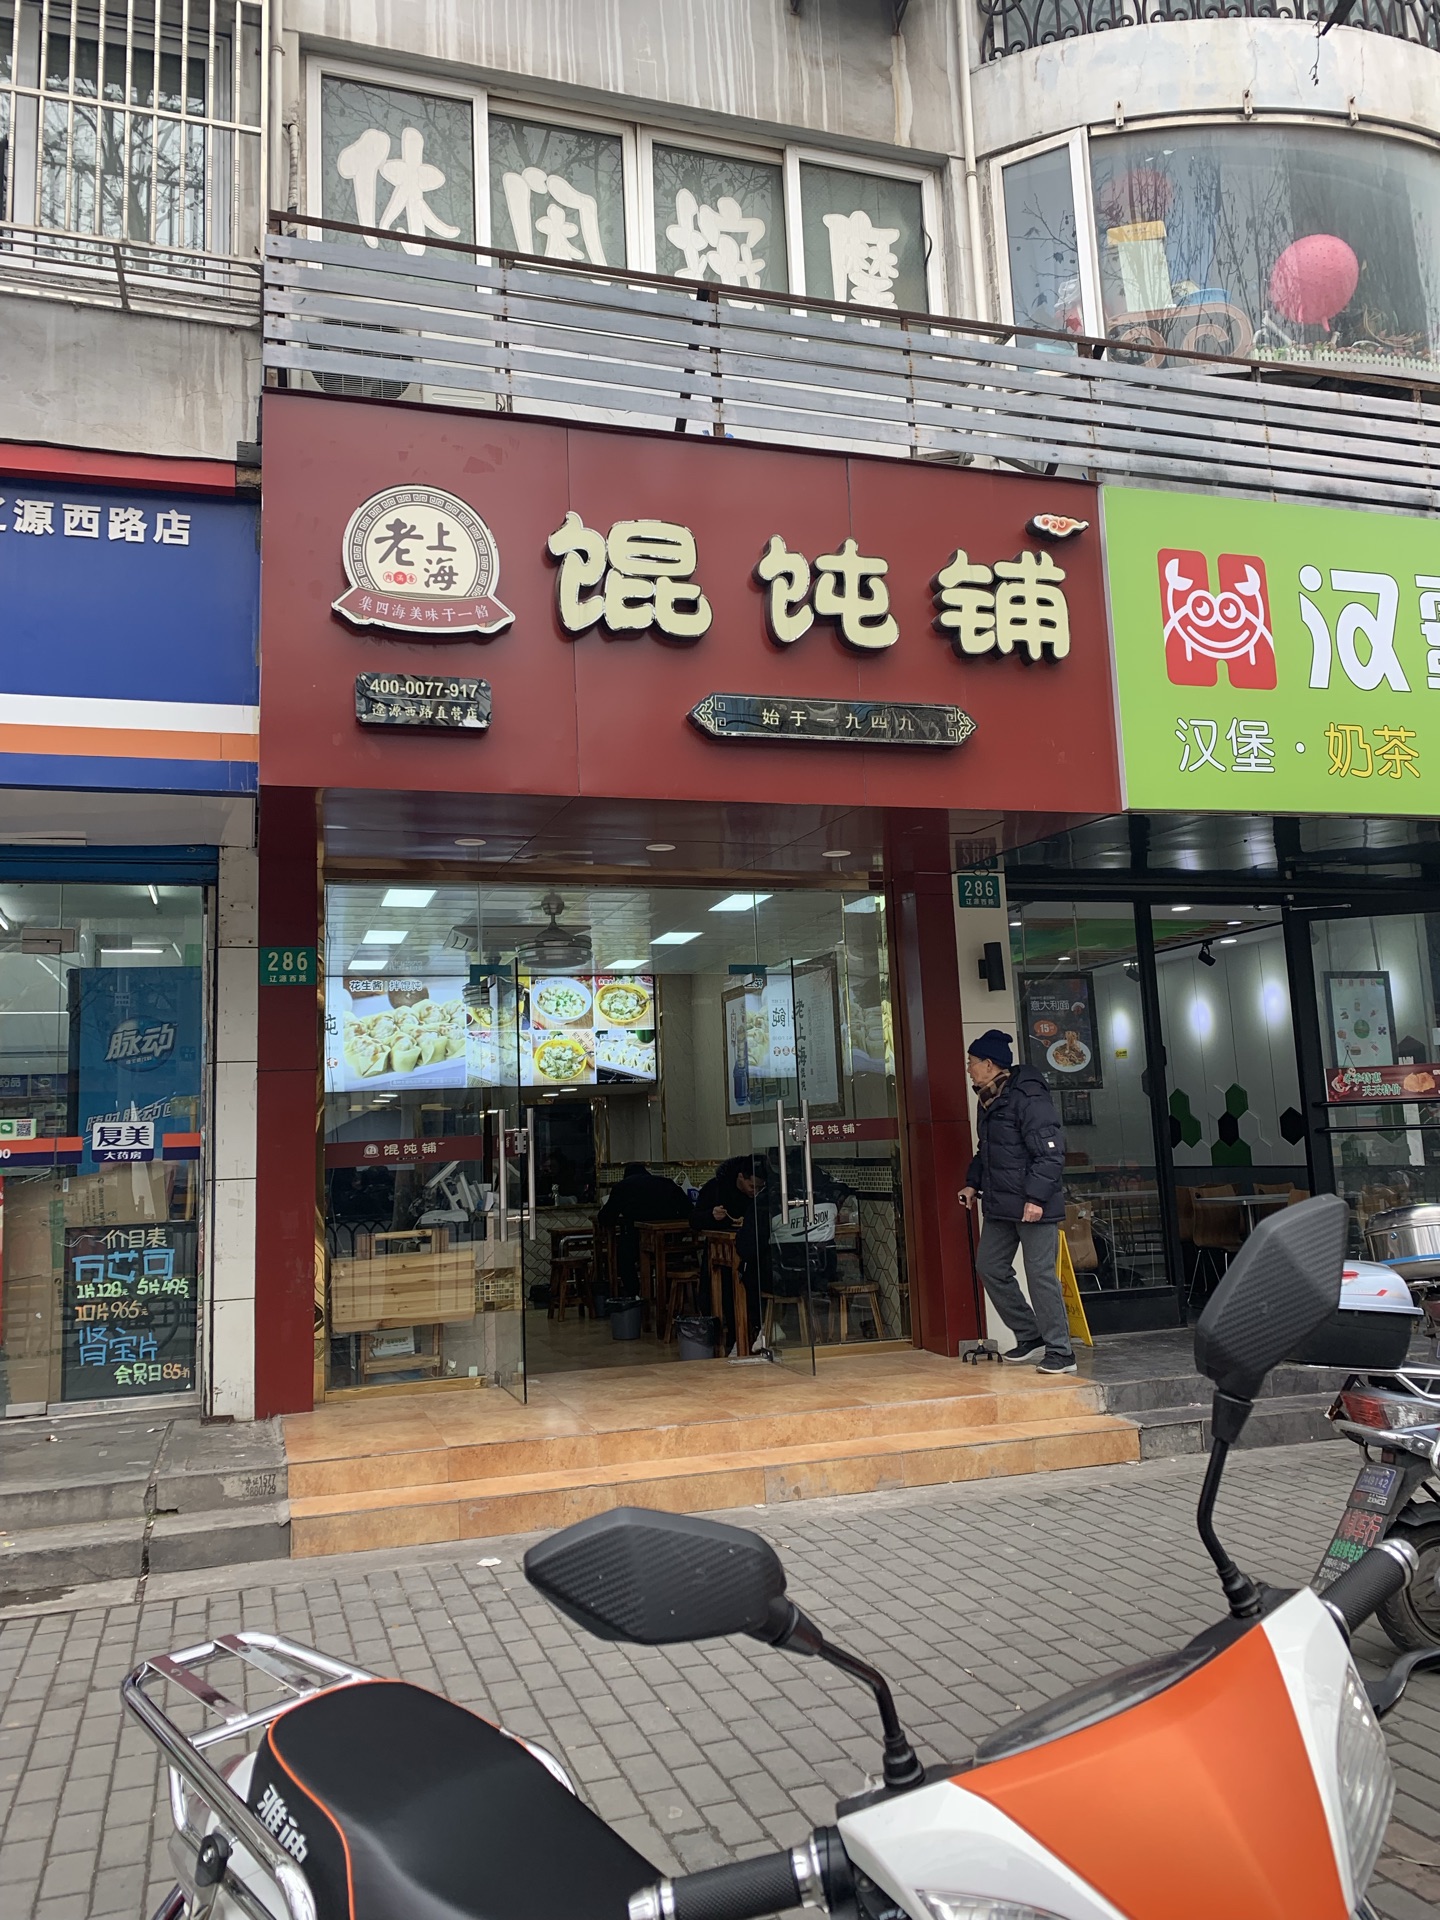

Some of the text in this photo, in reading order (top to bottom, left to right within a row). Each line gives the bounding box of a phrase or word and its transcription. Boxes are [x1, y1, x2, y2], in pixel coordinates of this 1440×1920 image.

[0, 497, 191, 546] 源西路店
[374, 518, 460, 591] 老上海
[546, 511, 1071, 662] 馄饨铺
[1298, 564, 1440, 692] 汉
[370, 679, 478, 699] 400-0077-917
[762, 708, 915, 732] 始于一九四九
[964, 881, 994, 897] 286
[268, 951, 308, 971] 286
[105, 1024, 175, 1060] 脉动
[97, 1126, 149, 1147] 复美
[811, 1123, 855, 1136] 馄饨铺
[104, 1151, 142, 1160] 大药房
[383, 1142, 437, 1156] 馄饨铺
[101, 1228, 167, 1249] 价目表
[79, 1327, 158, 1366] 肾宝片
